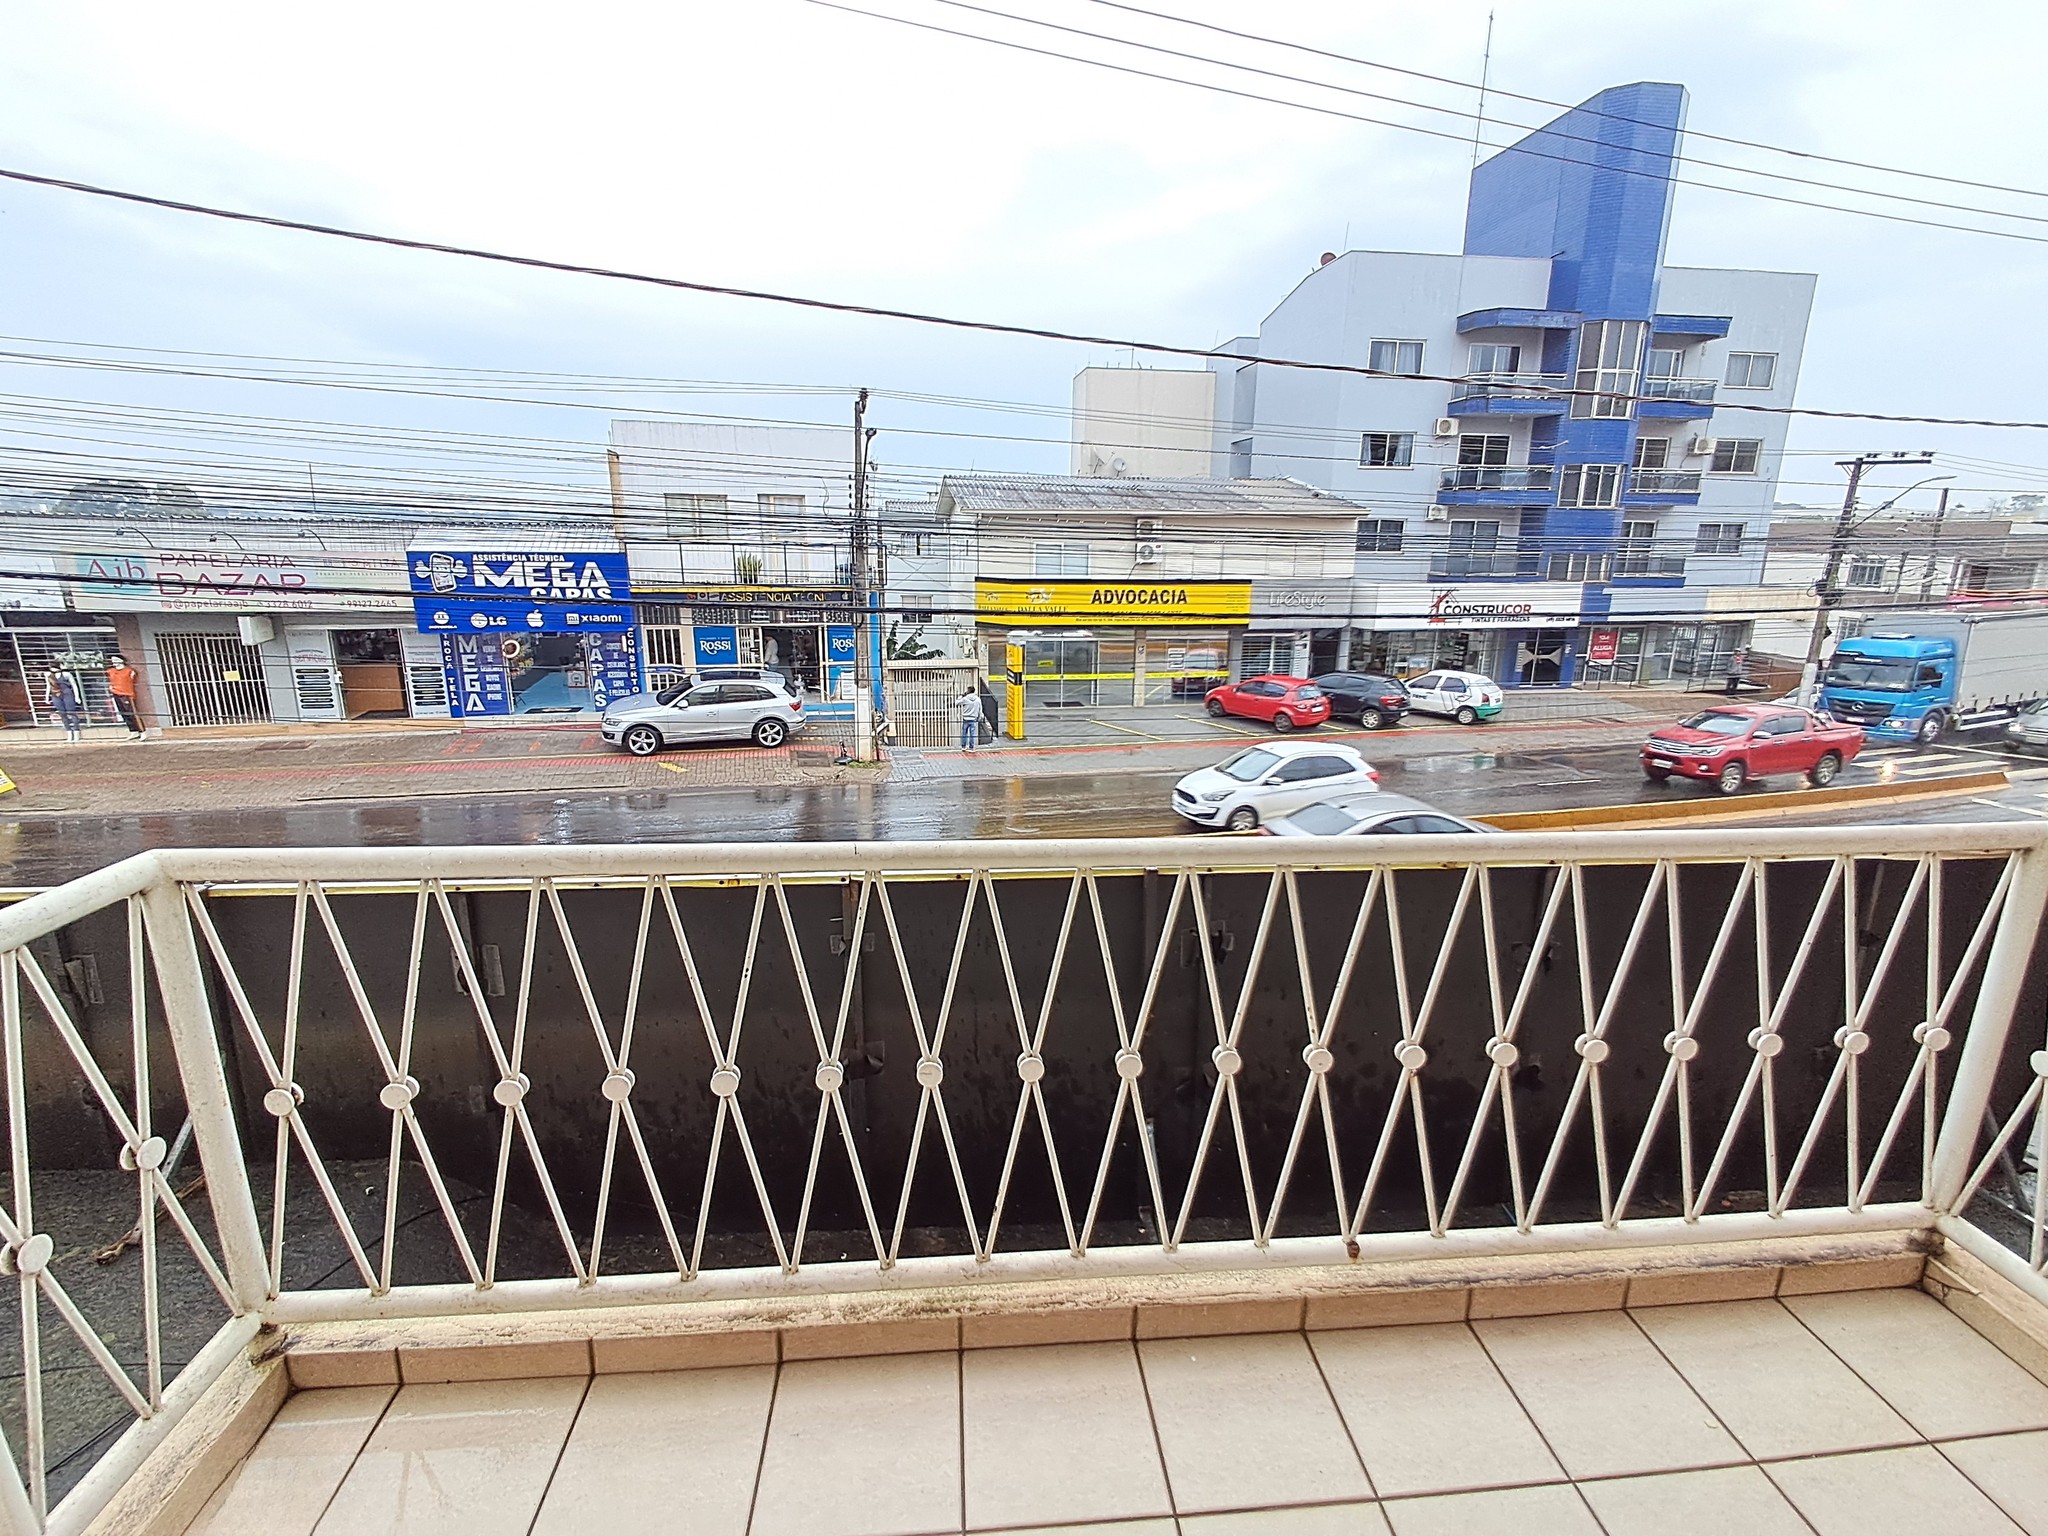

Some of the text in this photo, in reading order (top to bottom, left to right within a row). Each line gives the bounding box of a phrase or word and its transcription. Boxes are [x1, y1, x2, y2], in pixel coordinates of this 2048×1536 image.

[159, 553, 296, 568] PAPELARIA
[472, 553, 566, 562] ASSISTÊNCIA TÉCNICA
[473, 561, 610, 587] MEGA
[156, 572, 309, 596] BAZAR
[530, 587, 612, 604] CAPAS
[1091, 589, 1188, 605] ADVOCACIA
[1444, 604, 1531, 614] CONSTRUCOR
[488, 616, 508, 626] LG
[699, 640, 732, 655] ROSSI
[589, 633, 607, 707] CAPAS
[627, 631, 639, 693] CONSERTO
[457, 634, 486, 712] MEGA
[448, 678, 459, 706] TELA
